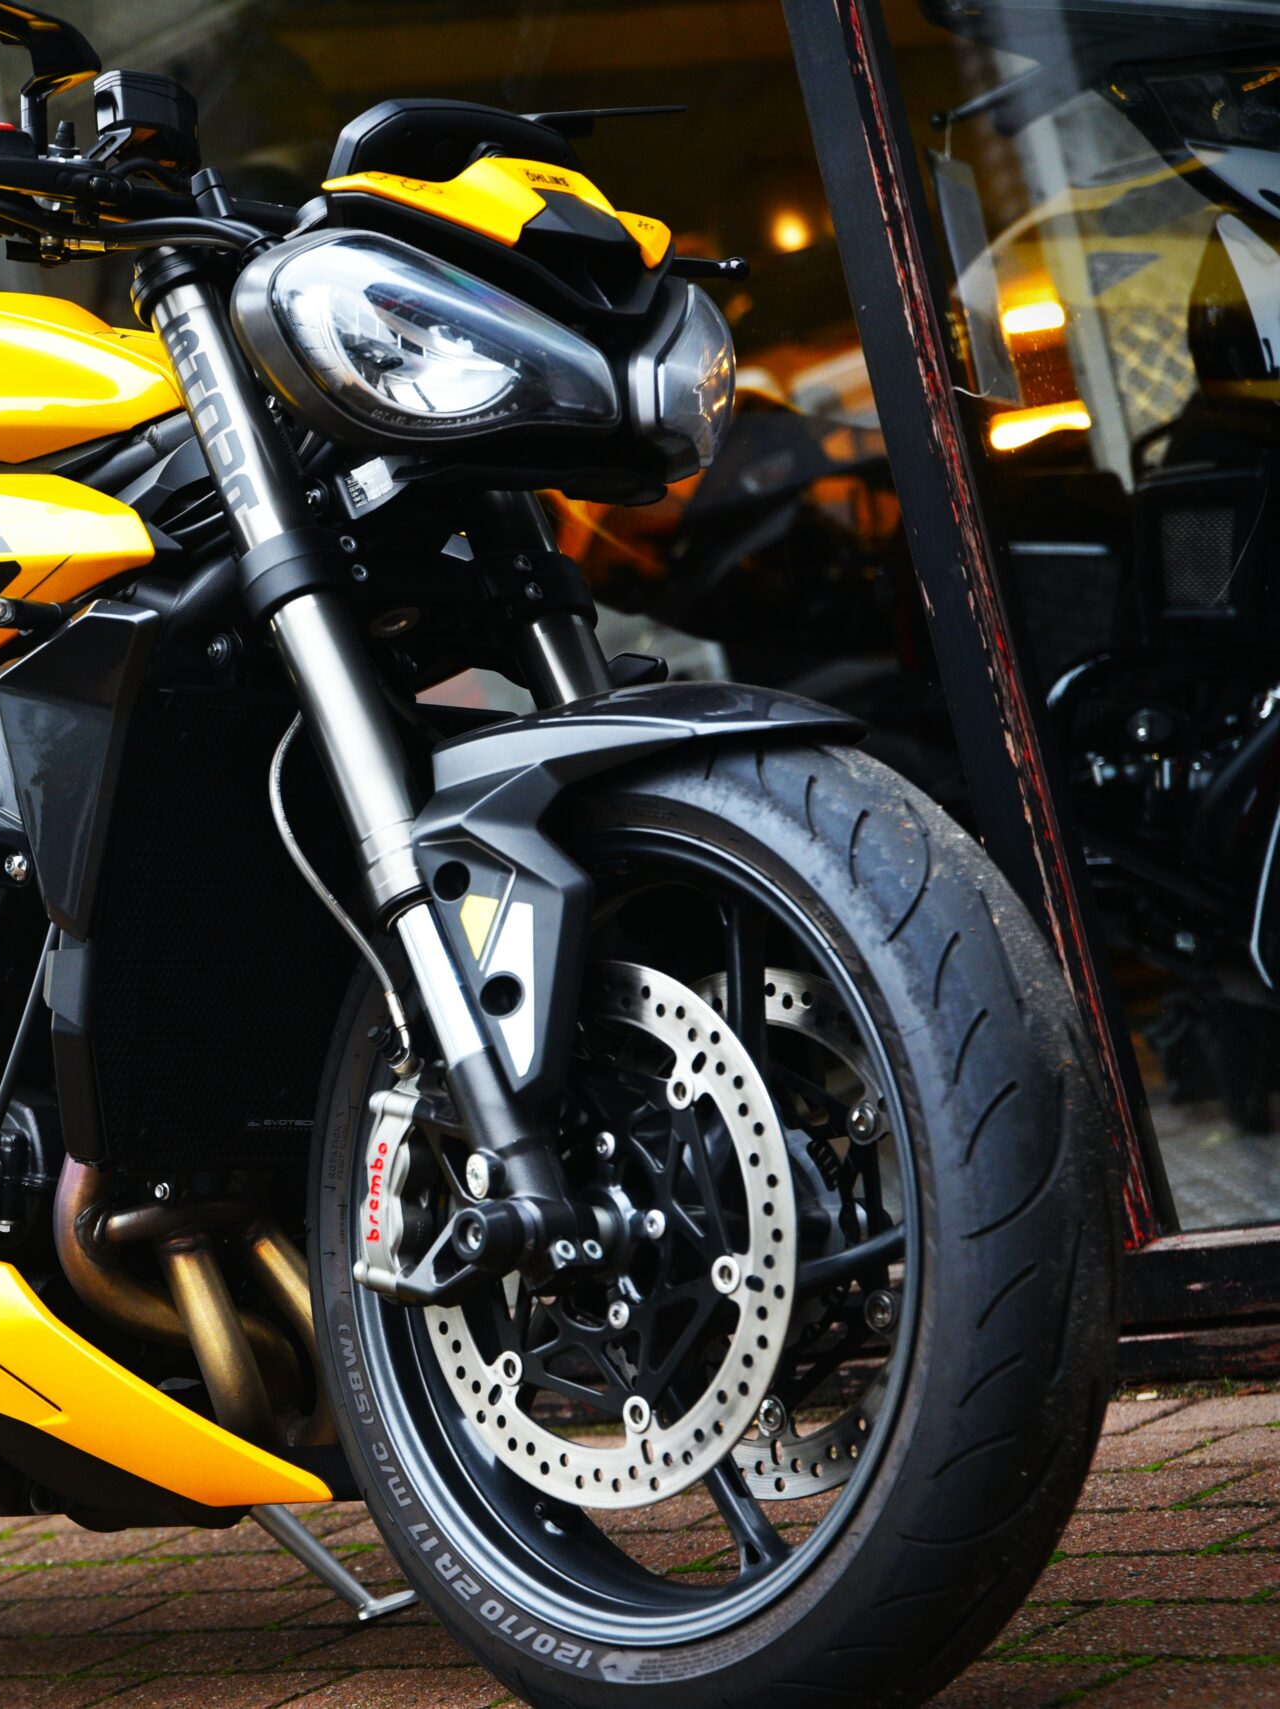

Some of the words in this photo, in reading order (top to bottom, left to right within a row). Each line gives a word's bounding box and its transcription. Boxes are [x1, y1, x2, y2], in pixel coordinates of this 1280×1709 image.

[366, 1142, 389, 1243] brembo
[338, 1323, 376, 1425] (58W)
[408, 1522, 440, 1552] 17
[479, 1599, 592, 1669] 120/70
